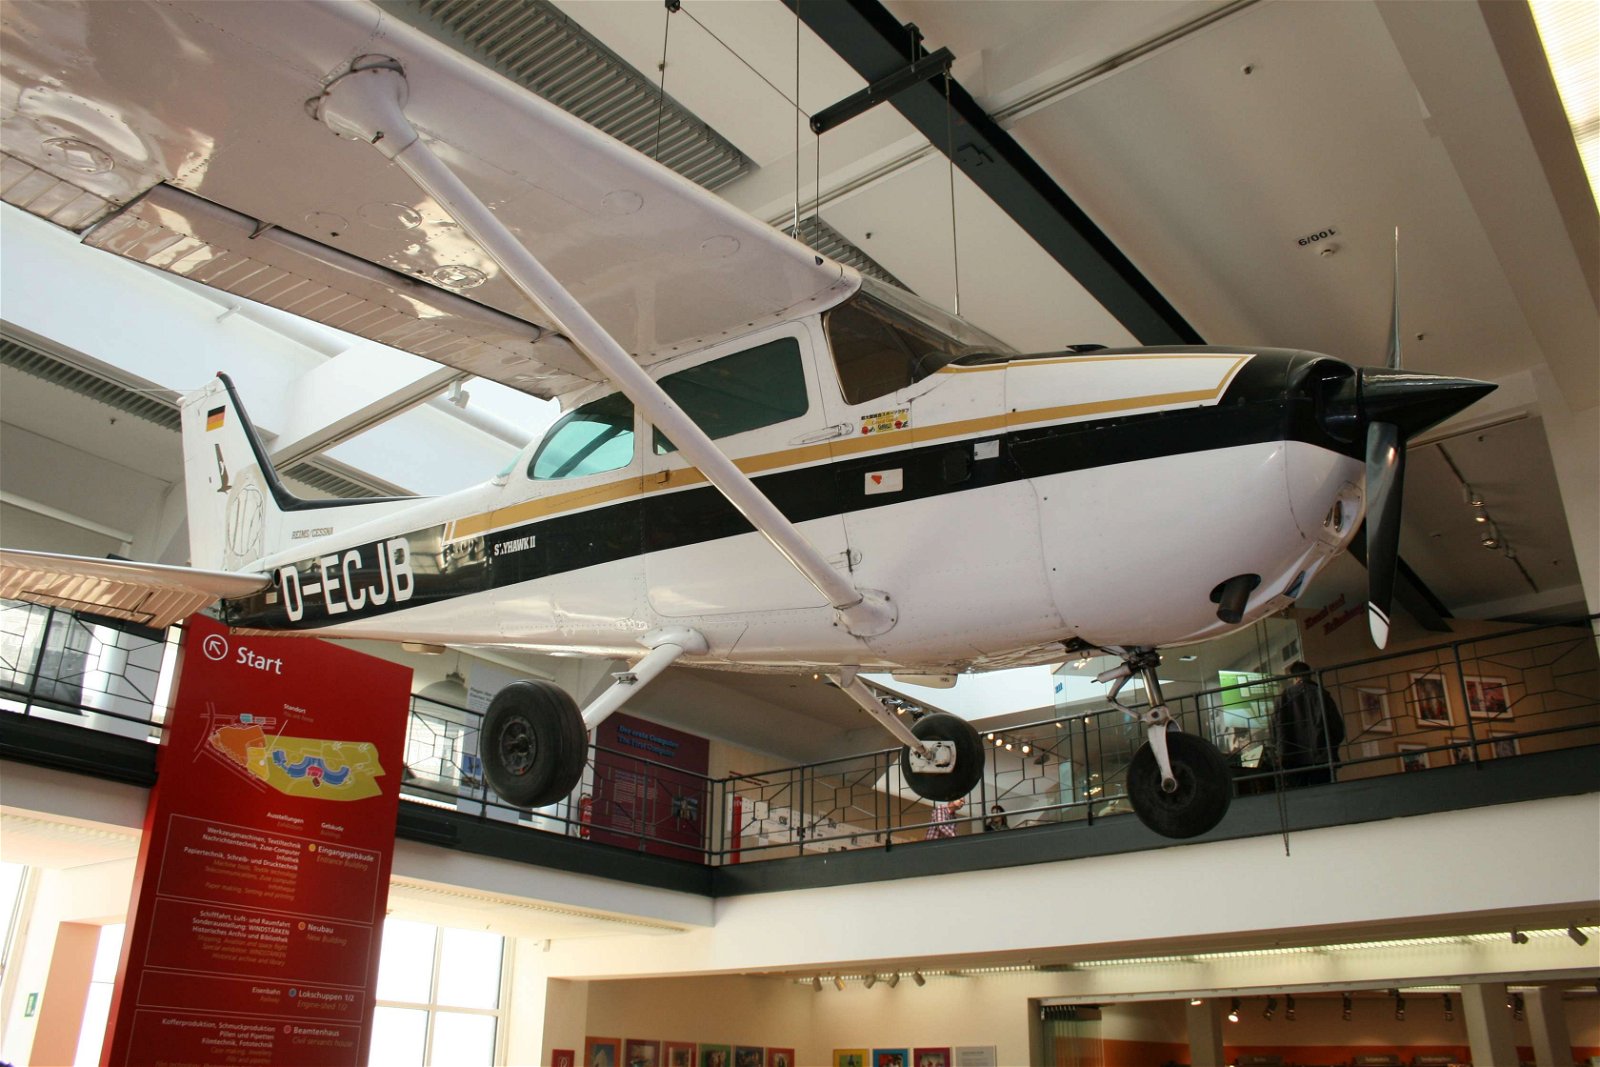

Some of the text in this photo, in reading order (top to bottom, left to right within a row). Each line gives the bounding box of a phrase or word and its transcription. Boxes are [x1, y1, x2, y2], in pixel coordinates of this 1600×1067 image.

[280, 537, 414, 622] D-ECJB
[236, 646, 282, 674] Start
[283, 703, 306, 714] Standort
[266, 812, 304, 824] Ausstellungen
[321, 822, 344, 832] Gebäude
[207, 826, 301, 848] Werkzeugmaschinen, Textiltechnik
[202, 834, 300, 856] Nachrichtentechnik, Zuse-Computer
[184, 846, 225, 859] Papiertechnik,
[227, 854, 249, 862] Schreib-
[263, 860, 298, 870] Drucktechnik
[318, 846, 374, 862] Eingangsgebäude
[192, 917, 290, 936] Sonderausstellung: WINDSTÄRKEN
[261, 919, 291, 928] Raumfahrt
[308, 923, 334, 934] Neubau
[192, 925, 226, 936] Historisches
[228, 929, 247, 938] Archiv
[260, 934, 288, 943] Bibliothek
[252, 986, 281, 996] Eisenbahn
[298, 990, 342, 1002] Lokschuppen
[162, 1018, 275, 1032] Kofferproduktion, Schmuckproduktion
[293, 1026, 340, 1037] Beamtenhaus
[202, 1038, 237, 1046] Filmtechnik,
